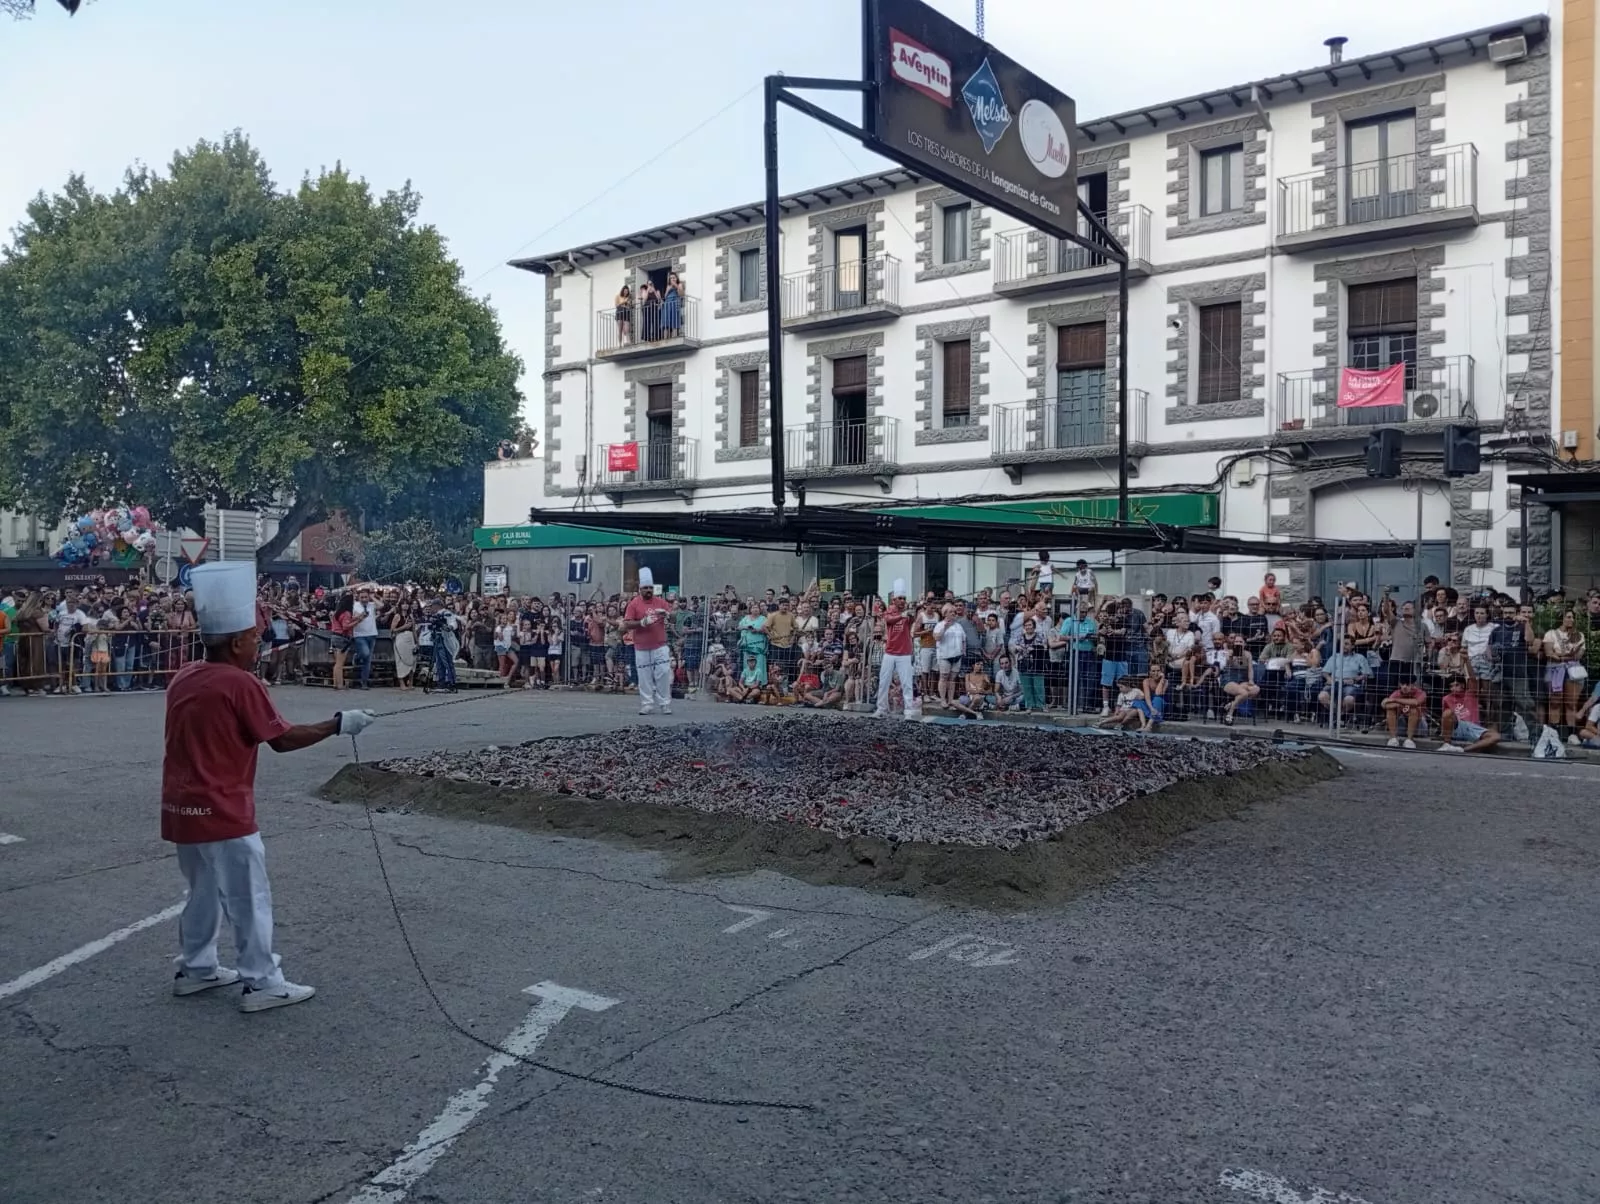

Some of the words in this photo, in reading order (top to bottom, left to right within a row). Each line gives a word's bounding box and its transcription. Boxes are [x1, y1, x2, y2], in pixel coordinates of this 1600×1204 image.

[972, 95, 1009, 126] Melsa
[907, 129, 923, 149] LOS
[923, 136, 940, 158] TRES
[940, 145, 972, 173] SABORES
[972, 159, 982, 177] DE
[982, 166, 991, 181] LA
[991, 171, 1029, 200] Longaniza
[1029, 190, 1039, 205] de
[1039, 196, 1060, 215] Graus
[180, 806, 213, 816] GRAUS
